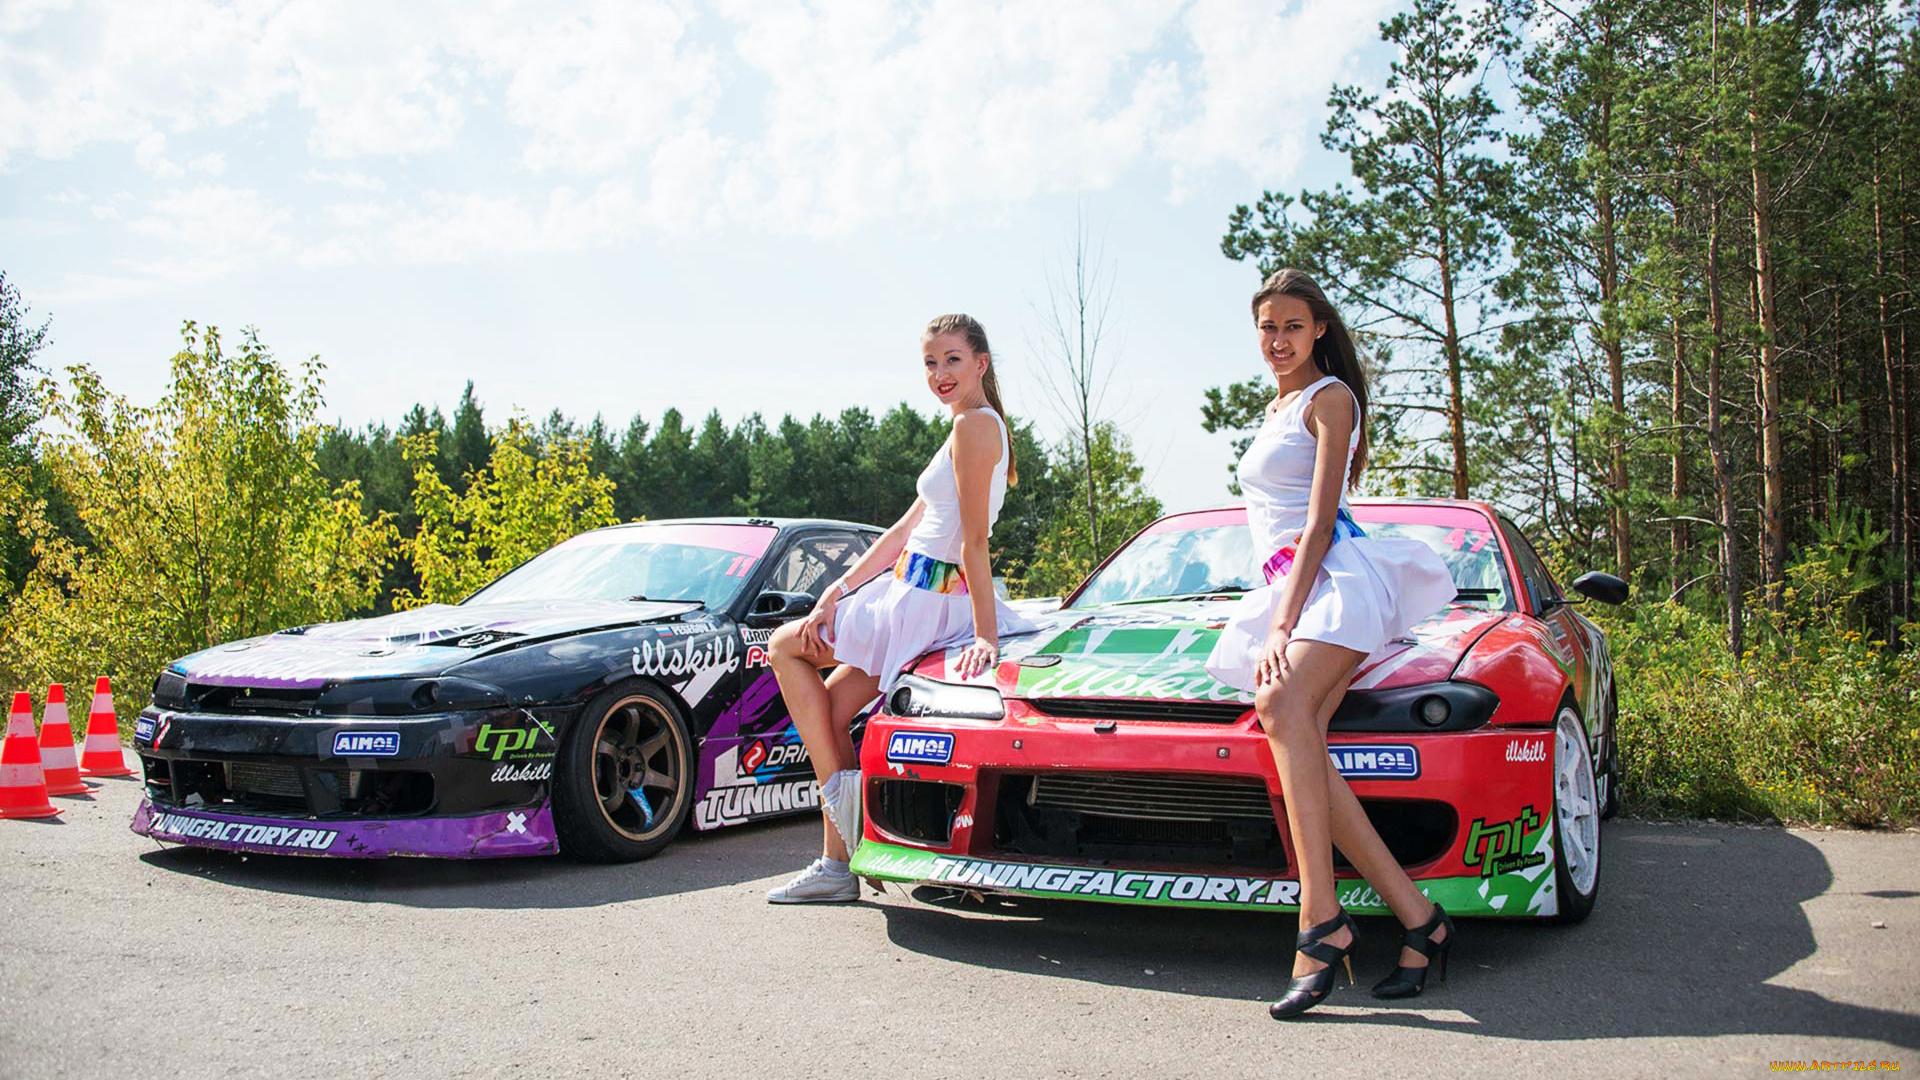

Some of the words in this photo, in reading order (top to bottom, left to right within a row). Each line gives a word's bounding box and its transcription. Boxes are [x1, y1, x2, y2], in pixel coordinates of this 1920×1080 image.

[1442, 528, 1491, 552] 47
[725, 555, 757, 578] 11
[741, 629, 777, 644] BRID
[631, 634, 740, 677] illskill
[337, 737, 396, 751] AIMOL
[891, 738, 947, 757] AIMOL
[1505, 740, 1547, 762] illskill
[491, 762, 551, 782] illskill
[1328, 752, 1412, 770] AIMOL
[148, 812, 338, 850] TUNINGFACTORY.RU
[928, 857, 1300, 905] TUNINGFACTORY.R
